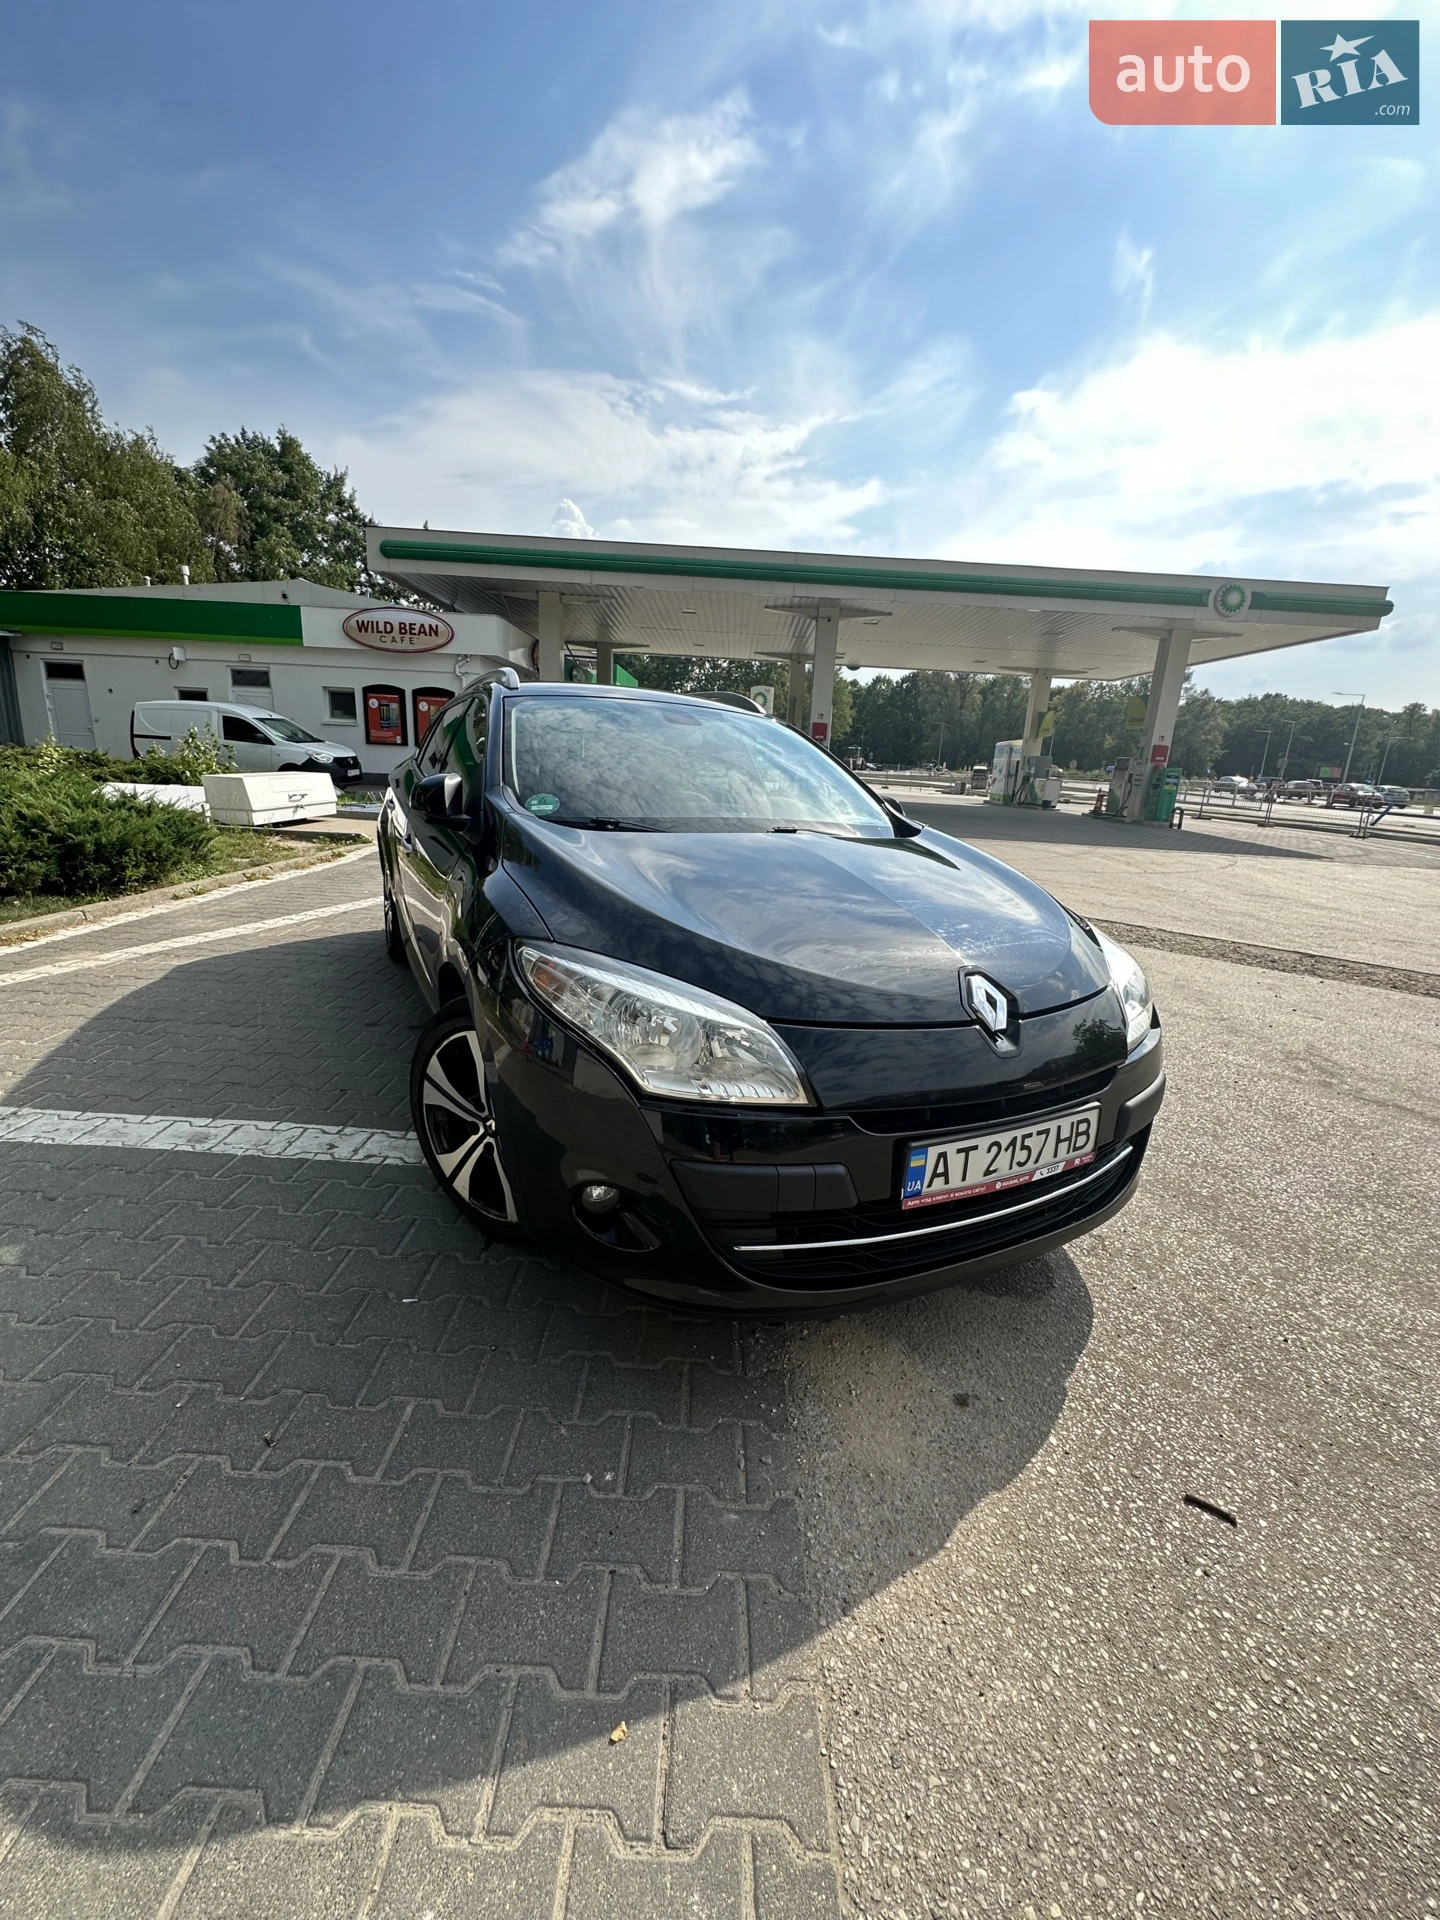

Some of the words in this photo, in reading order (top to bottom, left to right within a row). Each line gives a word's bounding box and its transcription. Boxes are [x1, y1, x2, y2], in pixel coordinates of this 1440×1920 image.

[355, 619, 394, 634] WILD
[398, 621, 439, 637] BEAN
[379, 635, 415, 645] CAFE
[926, 1144, 979, 1189] AT
[983, 1127, 1052, 1178] 2157
[1053, 1117, 1092, 1159] HB
[907, 1180, 921, 1192] UA
